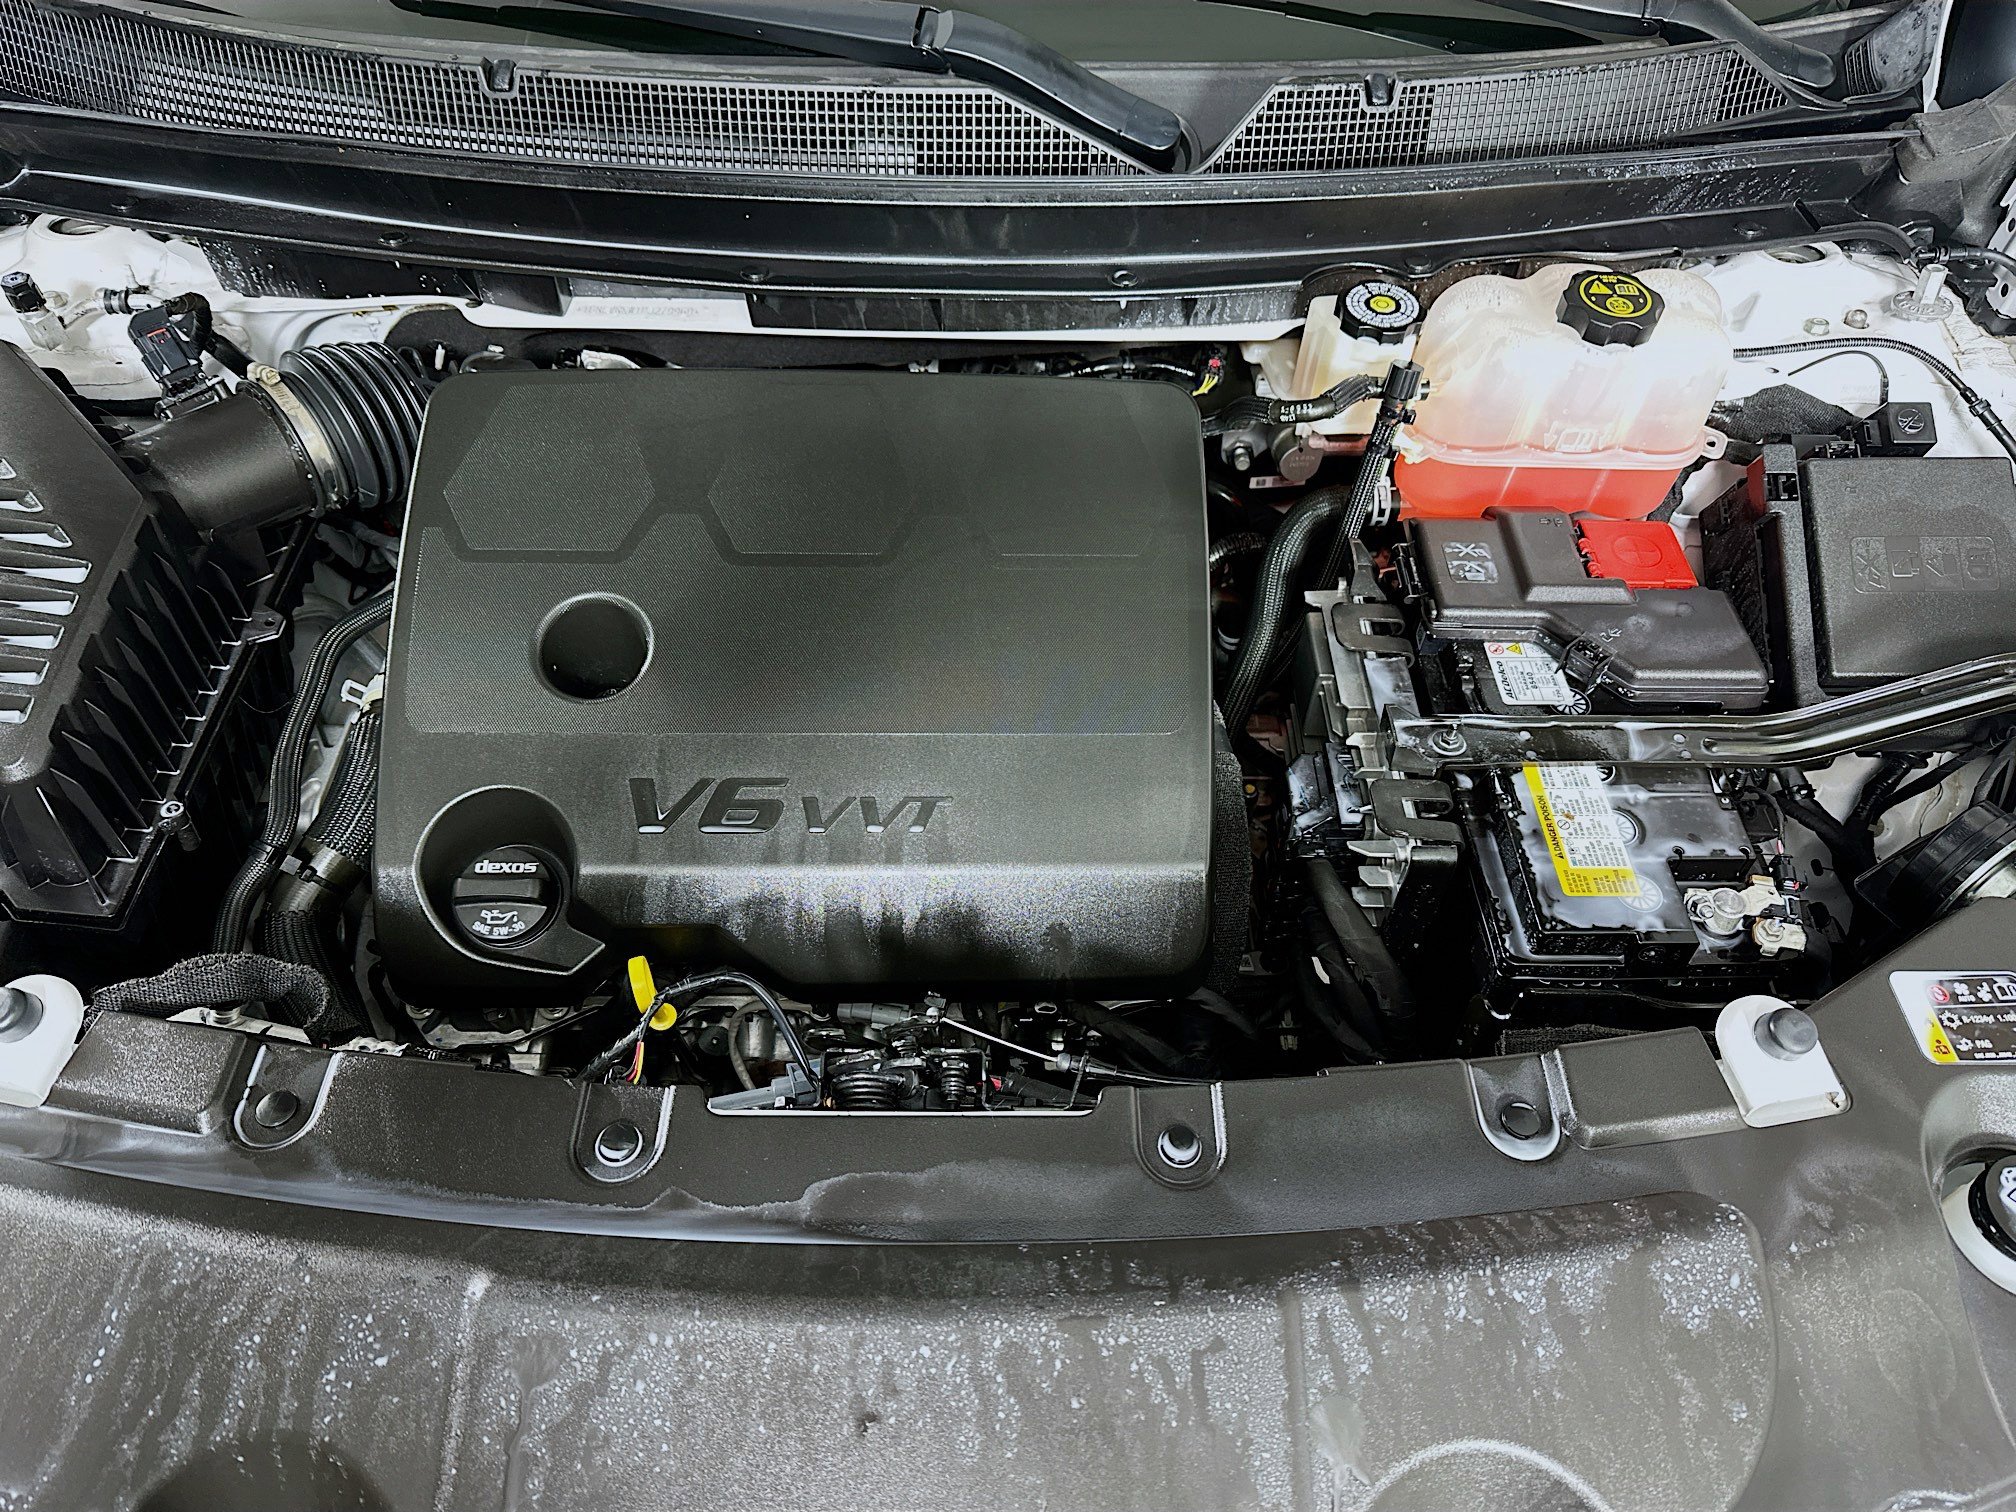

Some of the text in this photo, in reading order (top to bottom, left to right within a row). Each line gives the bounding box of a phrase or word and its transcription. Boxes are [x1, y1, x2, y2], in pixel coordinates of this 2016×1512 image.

[1496, 660, 1515, 699] ACDelco
[1526, 671, 1538, 690] 8540
[628, 776, 954, 834] V6 VVT
[474, 859, 540, 874] dexos
[472, 921, 526, 936] SAE 5W-30
